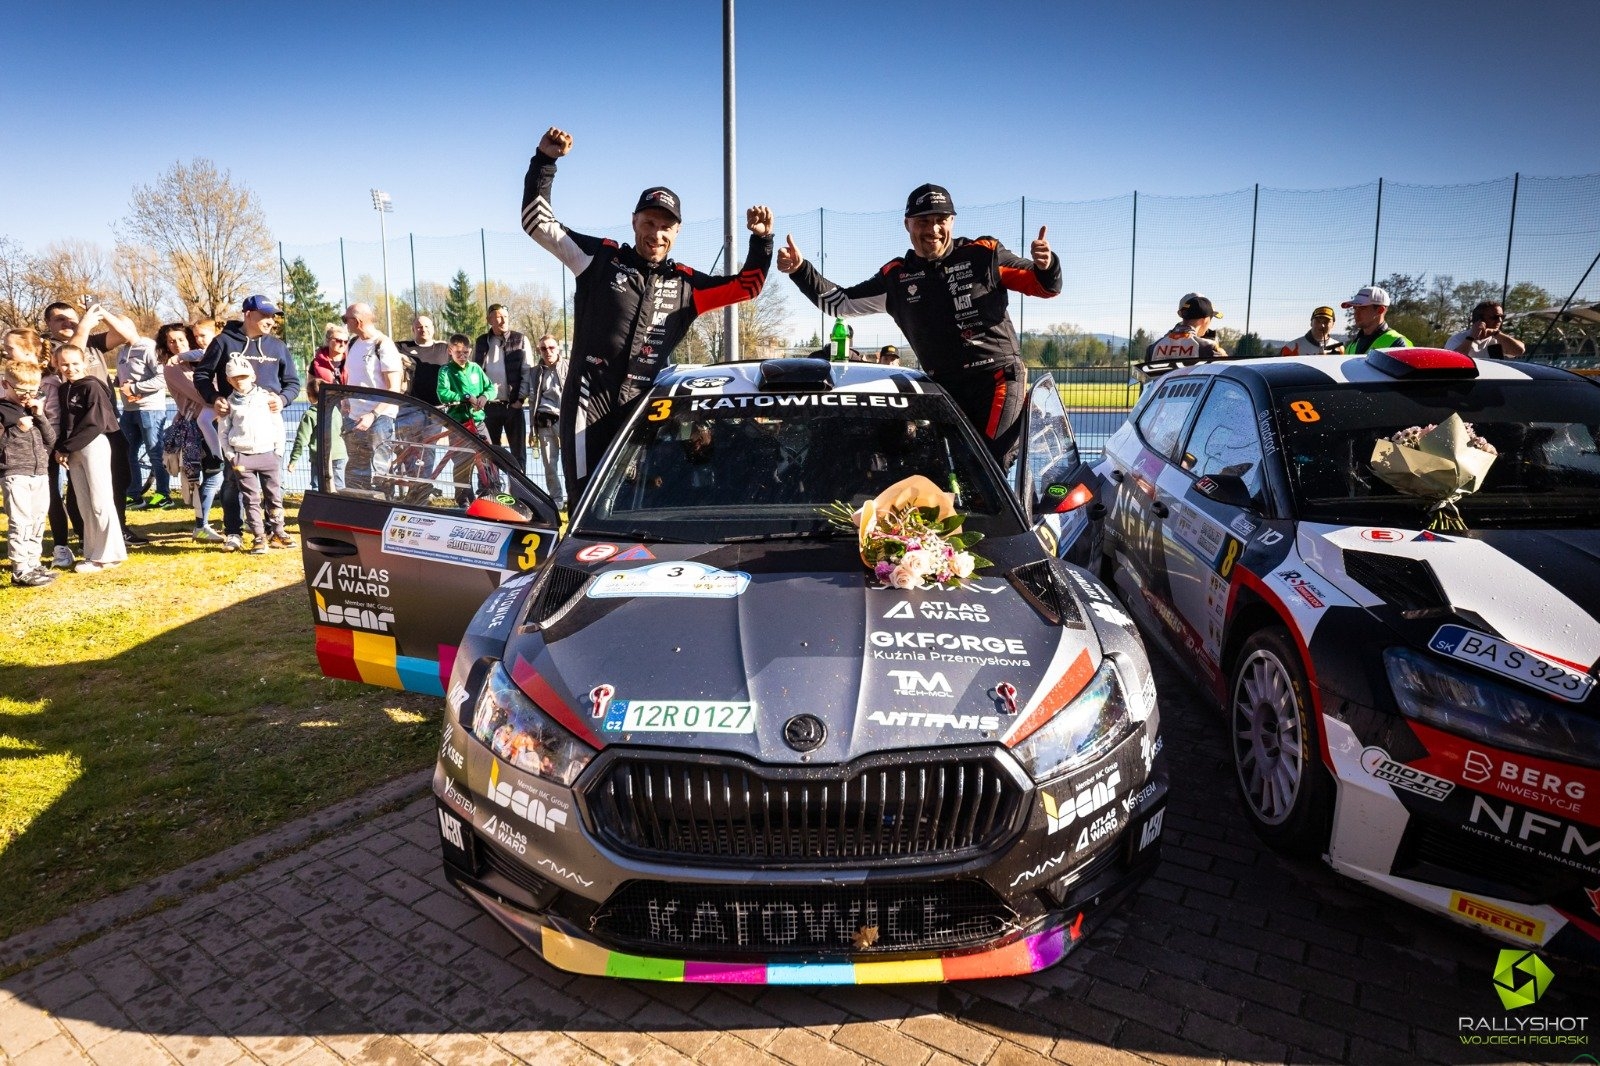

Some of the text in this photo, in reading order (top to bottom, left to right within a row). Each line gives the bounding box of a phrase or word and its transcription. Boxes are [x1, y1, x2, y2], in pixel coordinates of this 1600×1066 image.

[1157, 345, 1193, 356] NFM
[648, 399, 672, 421] 3
[690, 394, 909, 411] KATOWICE.EU
[1290, 400, 1320, 422] 8
[517, 533, 541, 571] 3
[1221, 538, 1238, 577] 8
[338, 563, 389, 583] ATLAS
[667, 567, 684, 578] 3
[338, 578, 390, 597] WARD
[920, 601, 987, 613] ATLAS
[921, 610, 991, 622] WARD
[870, 631, 1028, 655] GKFORGE
[1436, 640, 1455, 652] SK
[873, 650, 1031, 666] Kuźnia Przemysłowa
[1461, 637, 1581, 690] BA S 323
[887, 669, 953, 692] TM
[894, 689, 954, 698] TECH-MOL
[606, 721, 622, 731] CZ
[867, 711, 999, 730] ANTRANS
[1075, 775, 1096, 792] Member
[1105, 762, 1119, 774] Group
[1373, 769, 1447, 799] WIZJA
[1379, 760, 1453, 790] MOTO
[1500, 761, 1586, 800] BERG
[517, 779, 570, 810] Member IMC Group
[1497, 781, 1581, 814] INWESTYCJE
[1090, 808, 1117, 832] ATLAS
[1090, 818, 1118, 842] WARD
[497, 829, 526, 855] WARD
[499, 820, 527, 845] ATLAS
[1461, 824, 1501, 842] NIVETTE
[1504, 838, 1535, 853] FLEET
[648, 897, 952, 945] KATOWICE
[1457, 897, 1536, 937] PIRELLI
